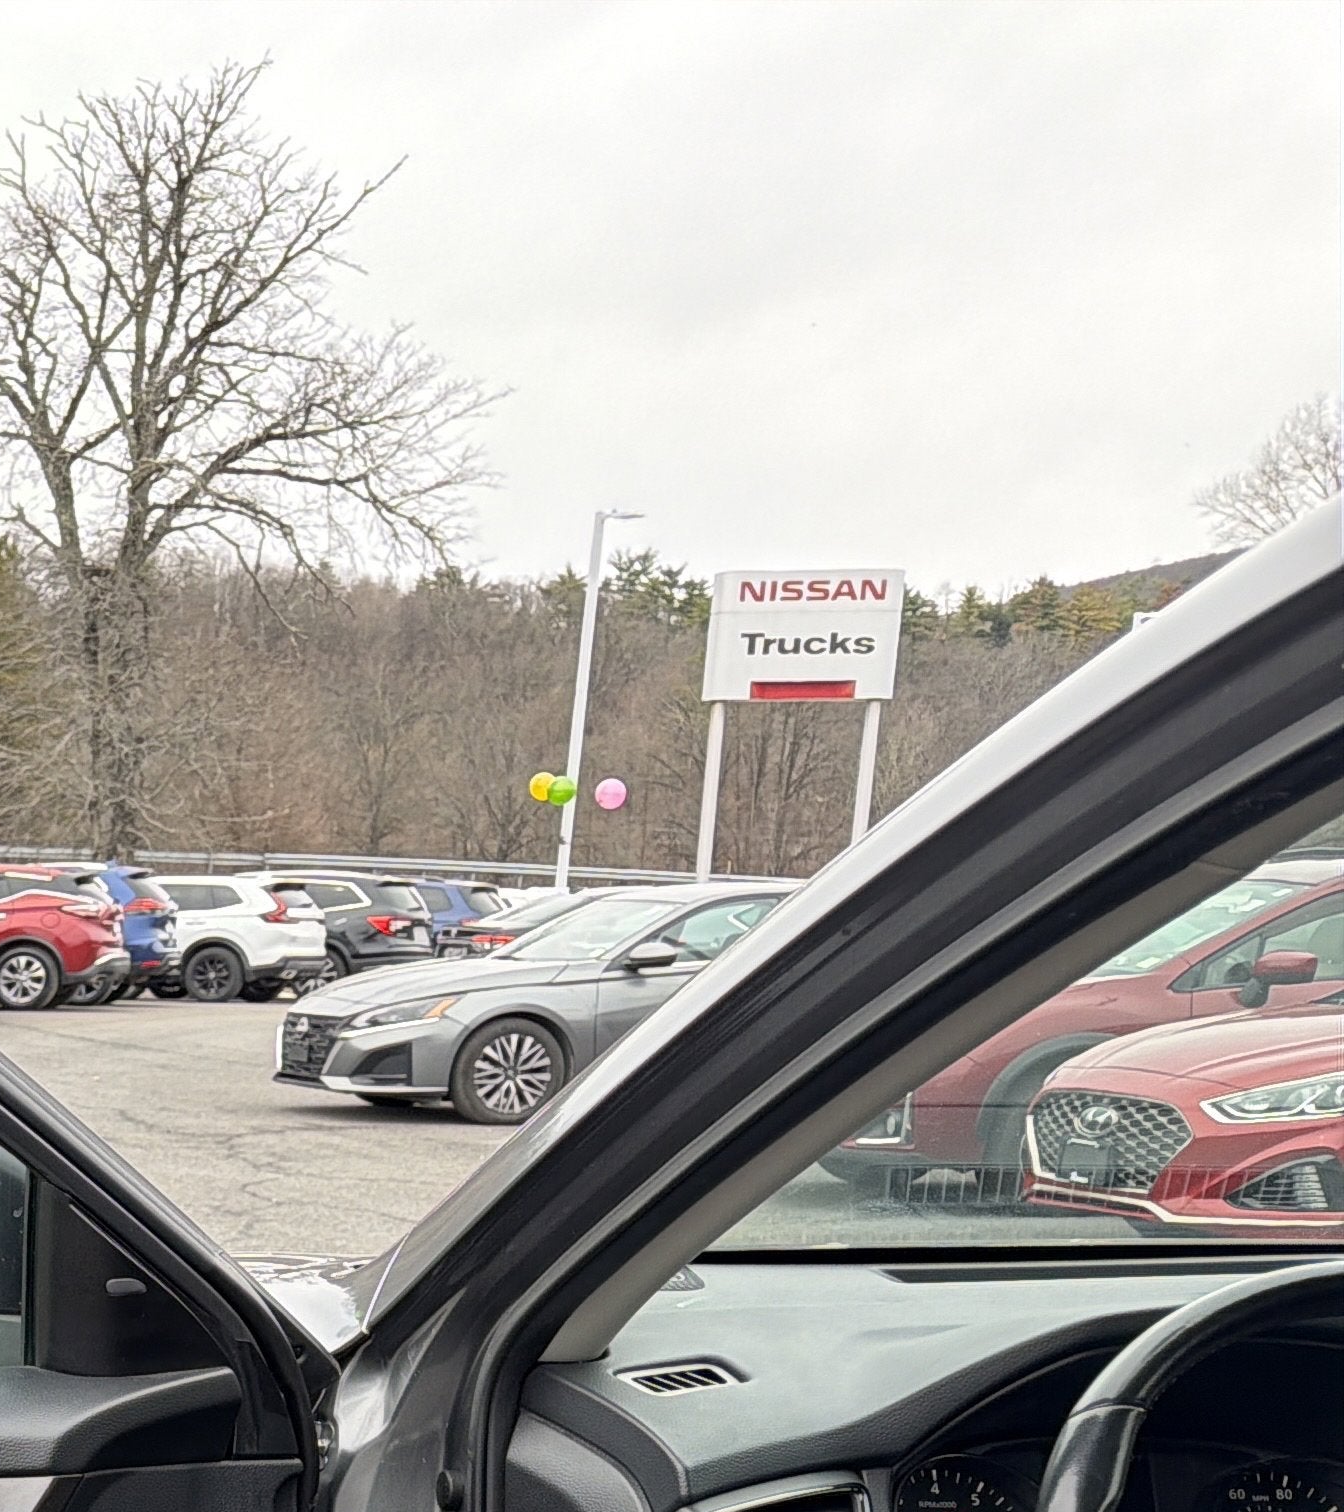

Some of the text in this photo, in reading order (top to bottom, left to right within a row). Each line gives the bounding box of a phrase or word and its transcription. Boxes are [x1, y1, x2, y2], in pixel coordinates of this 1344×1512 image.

[739, 579, 888, 602] NISSAN
[740, 632, 876, 655] Trucks
[930, 1482, 940, 1495] 4
[1228, 1488, 1293, 1500] 60 80
[970, 1494, 981, 1506] 5
